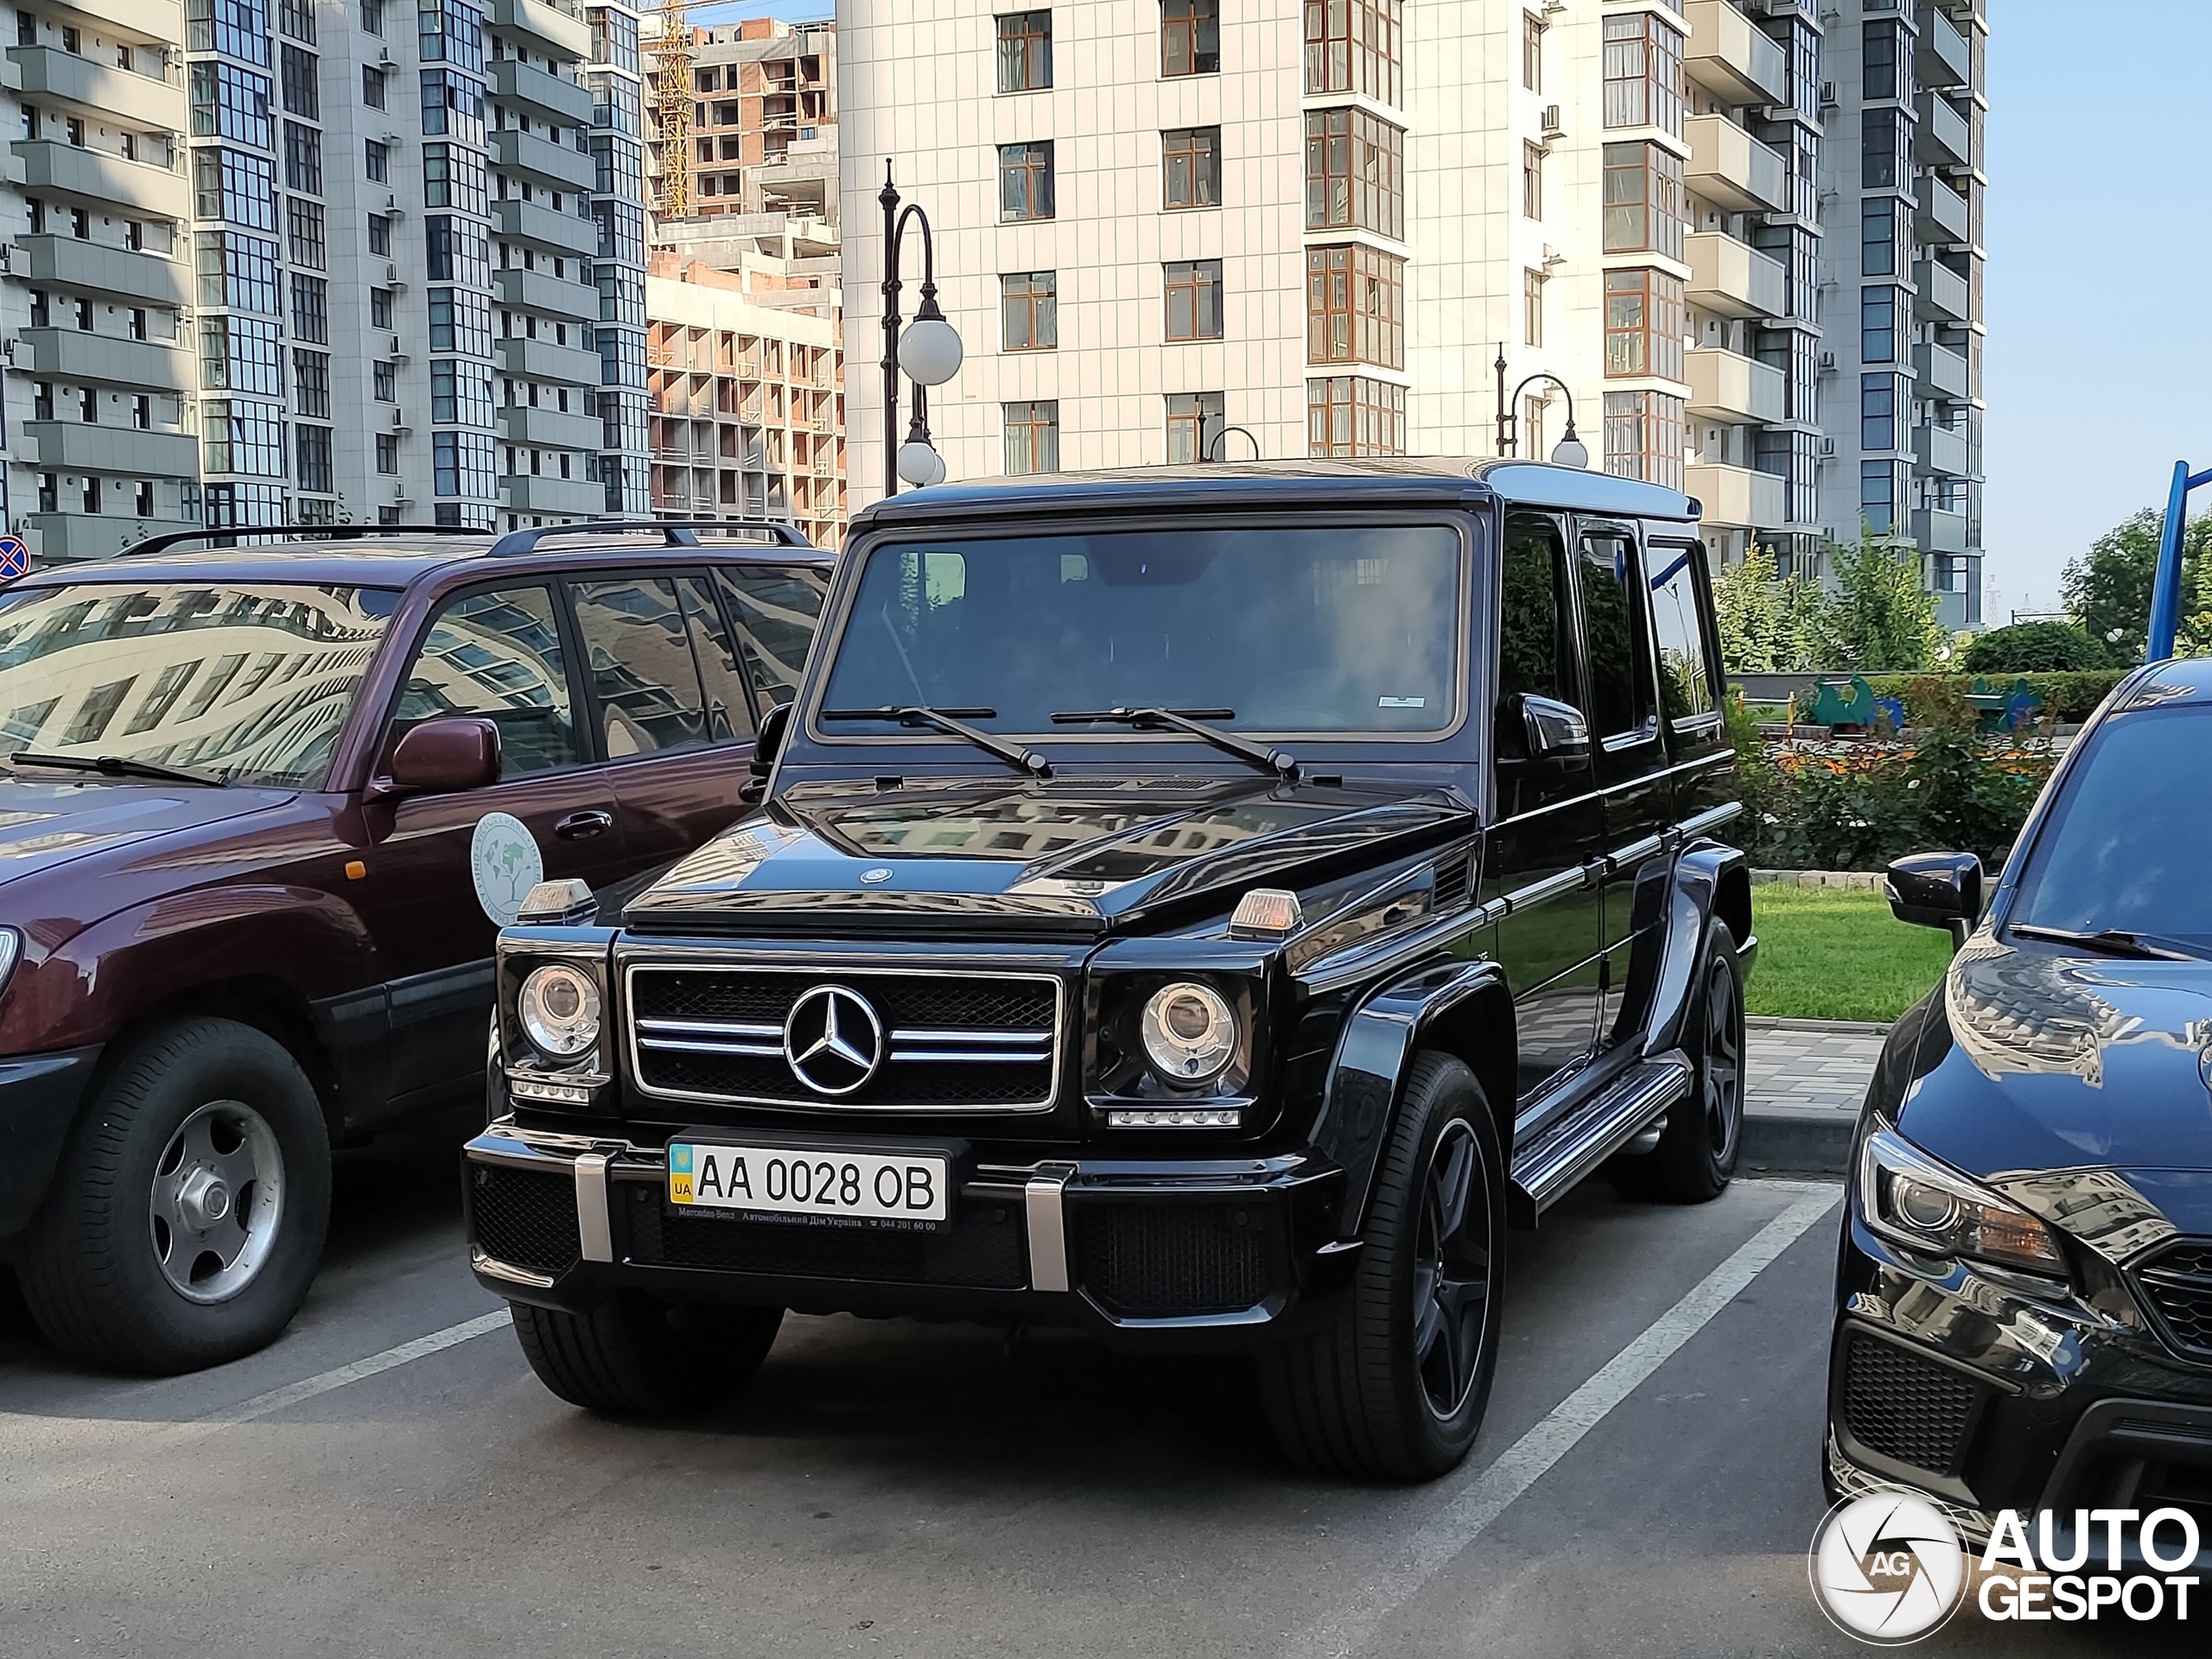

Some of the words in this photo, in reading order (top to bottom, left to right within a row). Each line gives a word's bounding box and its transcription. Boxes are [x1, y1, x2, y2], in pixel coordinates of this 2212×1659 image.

[475, 817, 503, 843] VICTORY
[504, 817, 527, 837] PARK
[474, 853, 483, 889] FUND
[480, 893, 510, 925] CHARITY
[675, 1183, 691, 1196] UA
[697, 1154, 753, 1199] AA
[766, 1159, 861, 1206] 0028
[874, 1165, 934, 1210] OB
[678, 1207, 735, 1219] Mercedes-Benz
[742, 1212, 808, 1224] Автомобільний
[809, 1215, 826, 1226] Дім
[897, 1221, 911, 1230] 201
[913, 1222, 925, 1230] 60
[925, 1222, 936, 1231] 00
